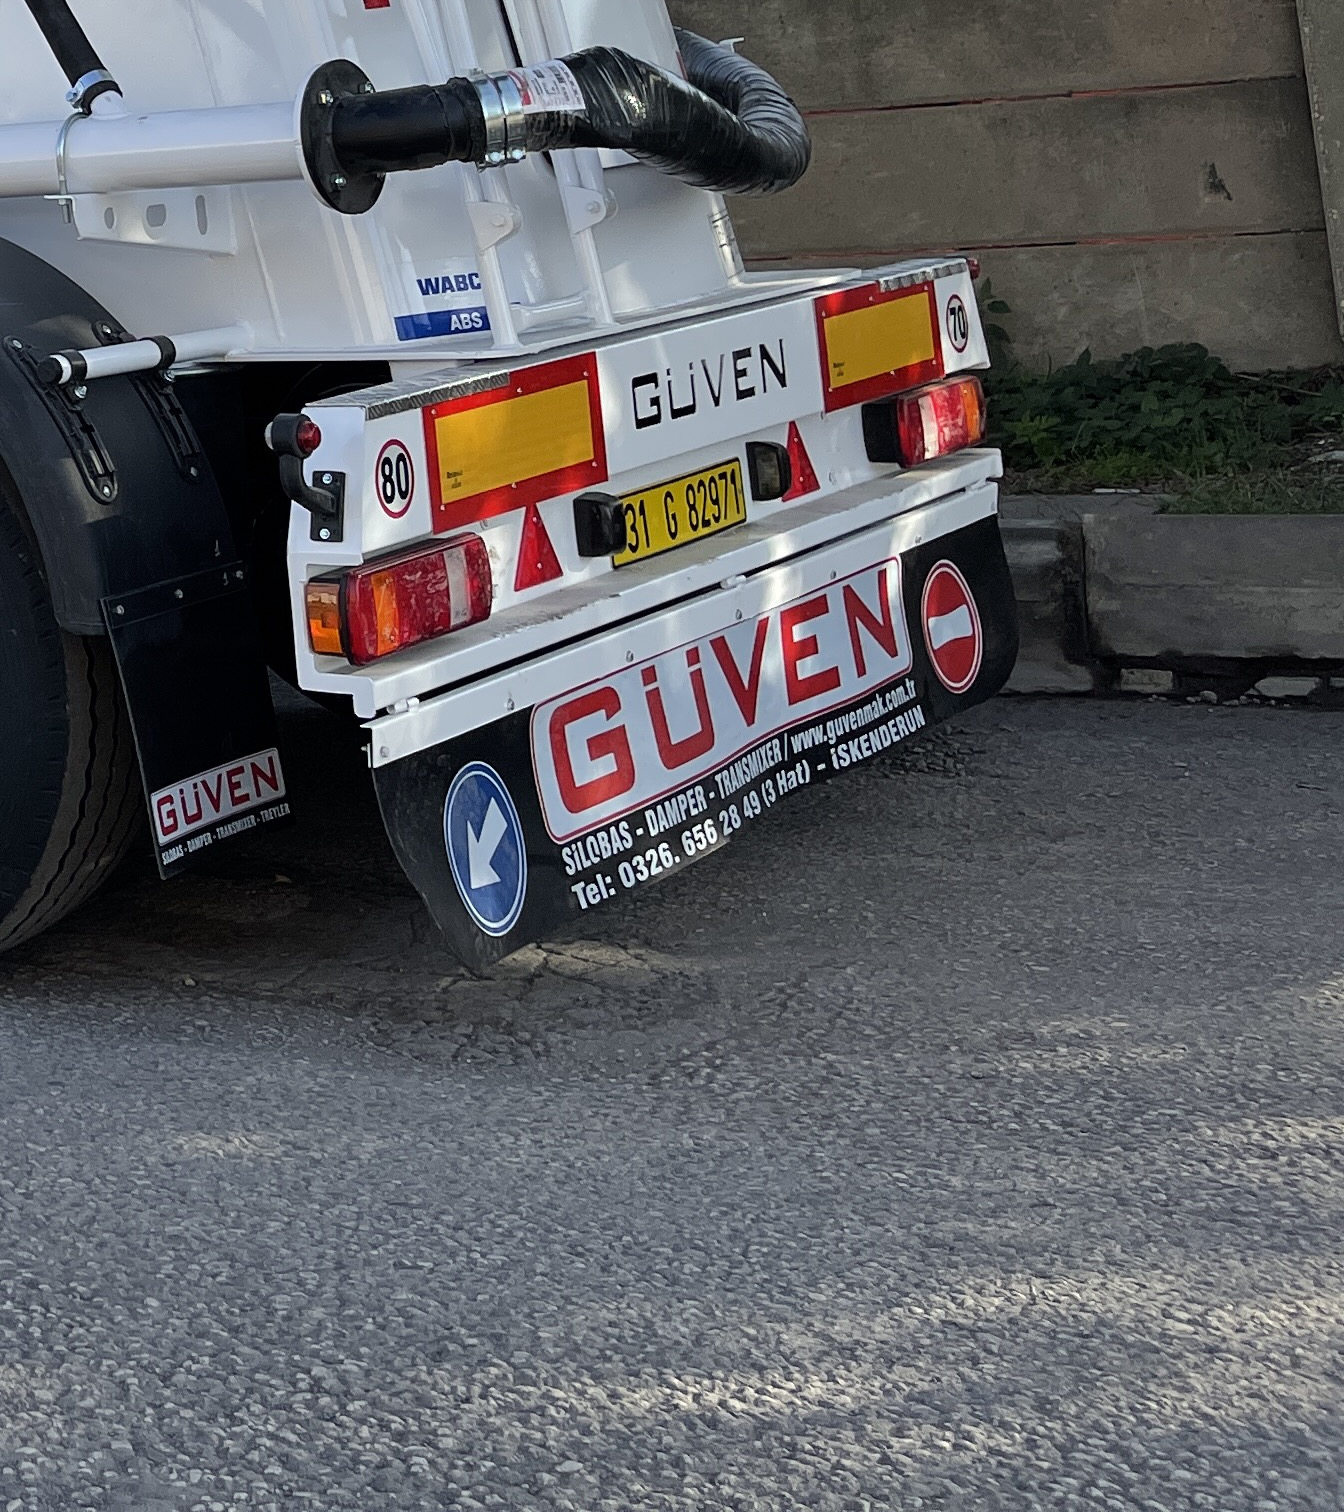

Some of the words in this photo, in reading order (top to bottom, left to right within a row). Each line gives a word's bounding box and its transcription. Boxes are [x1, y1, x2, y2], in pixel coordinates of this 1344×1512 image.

[416, 272, 482, 296] WABC
[450, 311, 483, 331] ABS
[948, 304, 967, 342] 70
[631, 338, 788, 430] GÜVEN
[380, 452, 410, 505] 80
[625, 498, 651, 553] 31
[663, 490, 678, 541] G
[685, 466, 742, 533] 82971
[548, 567, 900, 815] GÜVEN
[156, 755, 280, 837] GÜVEN
[644, 785, 708, 837] DAMPER
[714, 739, 783, 800] TRANSMIXER
[790, 677, 917, 755] www.guvenmak.com.tr
[571, 873, 617, 910] Tel:
[617, 841, 681, 888] 0326.
[681, 818, 719, 856] 656
[718, 804, 742, 836] 28
[743, 790, 762, 819] 49
[761, 778, 777, 808] (3
[776, 759, 811, 796] Hat)
